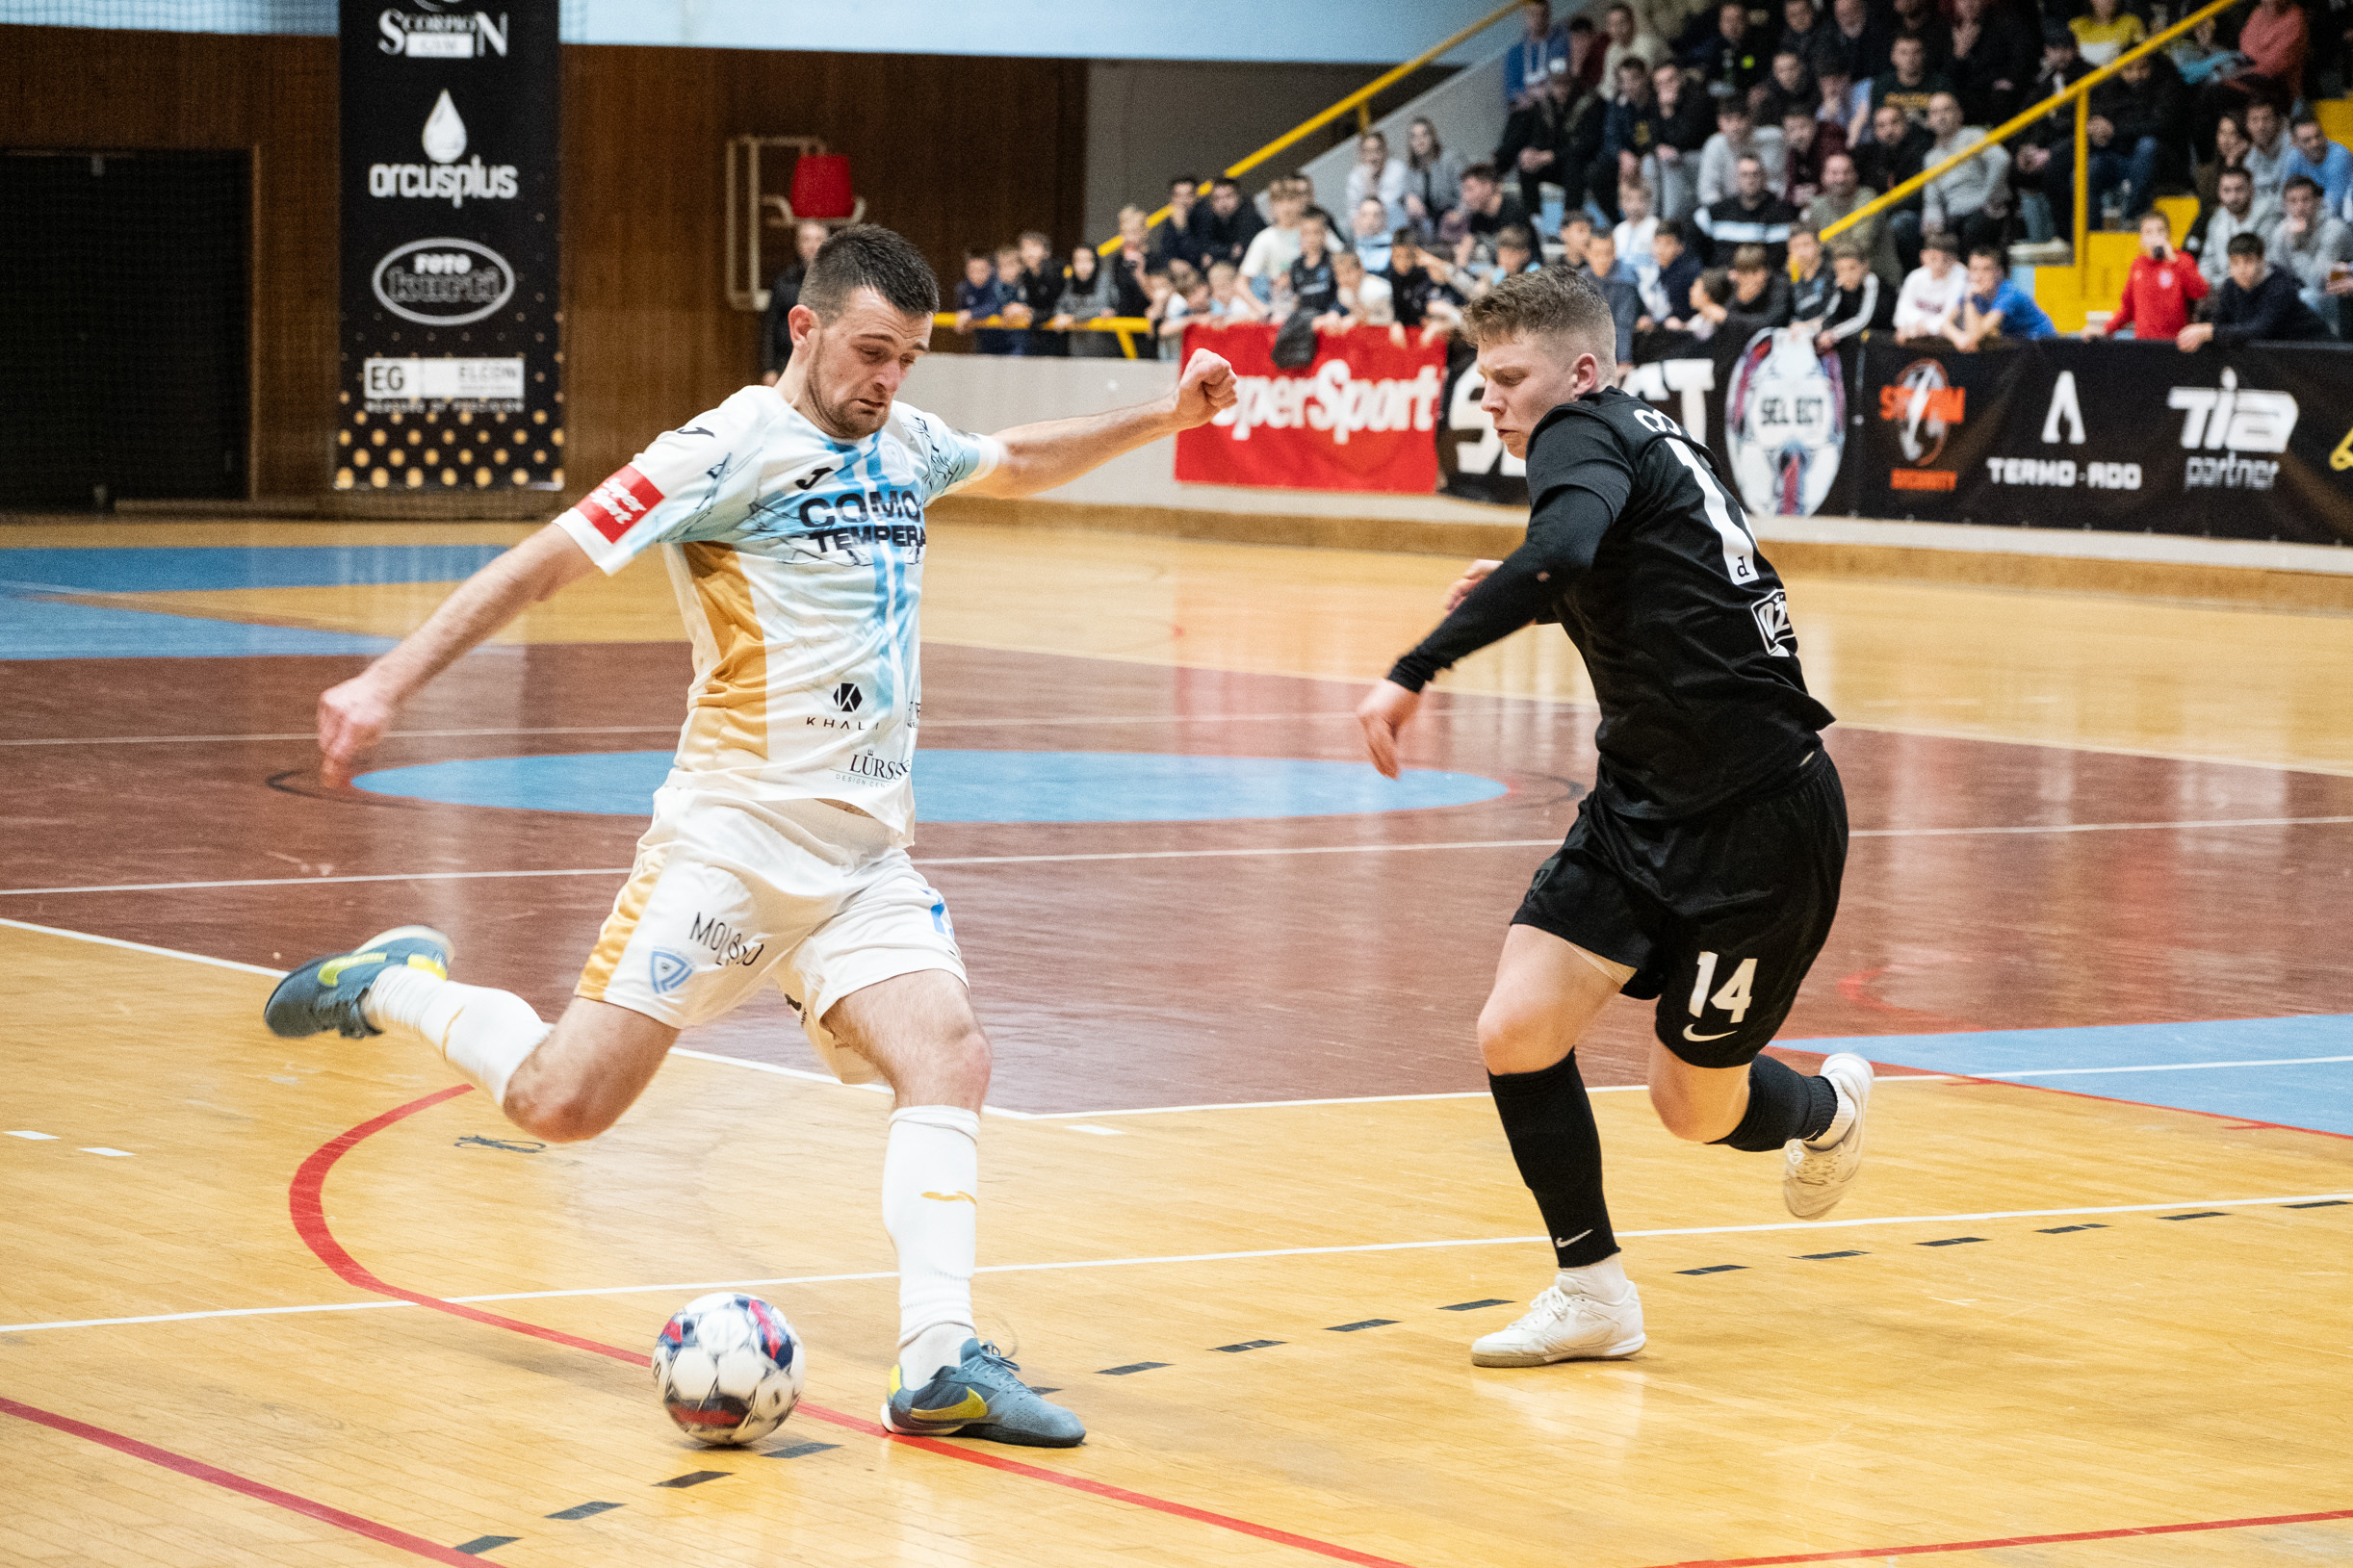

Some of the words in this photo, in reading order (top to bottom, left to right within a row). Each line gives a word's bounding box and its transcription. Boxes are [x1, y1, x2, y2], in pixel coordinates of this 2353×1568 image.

[369, 154, 518, 209] orcusplus
[371, 365, 404, 391] EG
[2184, 450, 2281, 492] partner
[798, 490, 921, 527] COMO
[1688, 951, 1759, 1024] 14
